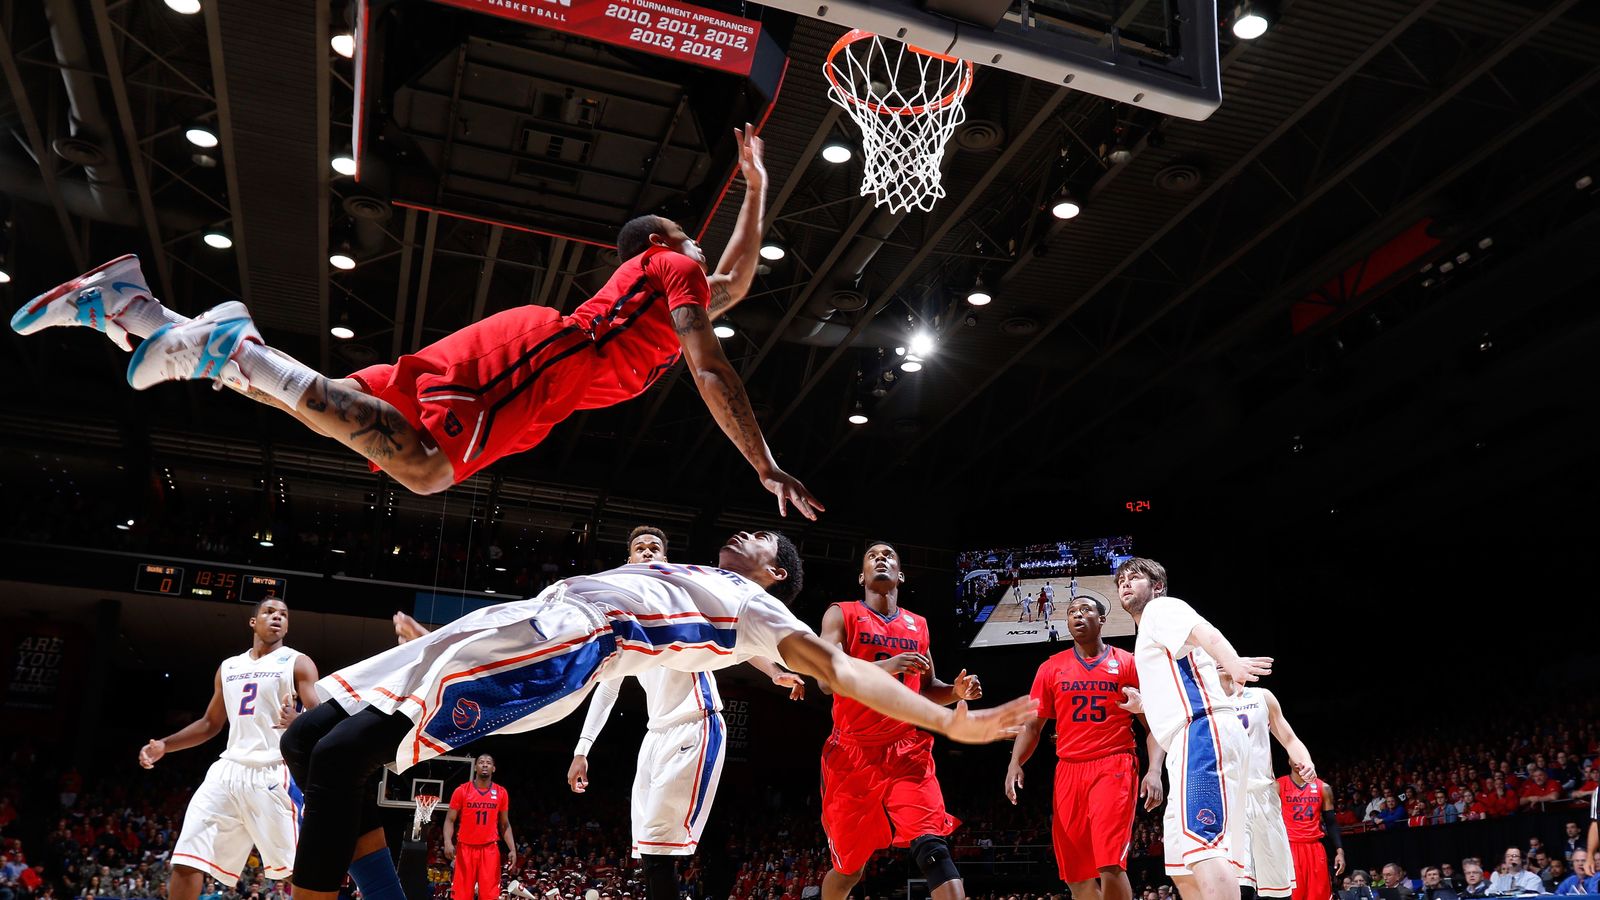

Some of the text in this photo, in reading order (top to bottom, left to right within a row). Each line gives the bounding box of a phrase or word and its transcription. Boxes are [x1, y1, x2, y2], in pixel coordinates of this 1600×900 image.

[605, 4, 749, 52] 2010, 2011, 2012,
[692, 13, 754, 35] APPEARANCES
[630, 27, 723, 61] 2013, 2014
[859, 632, 919, 651] DAYTON
[252, 671, 283, 679] STATE
[1061, 681, 1119, 693] DAYTON
[239, 683, 258, 715] 2
[1071, 695, 1107, 722] 25
[475, 810, 488, 825] 11
[1293, 805, 1314, 821] 24
